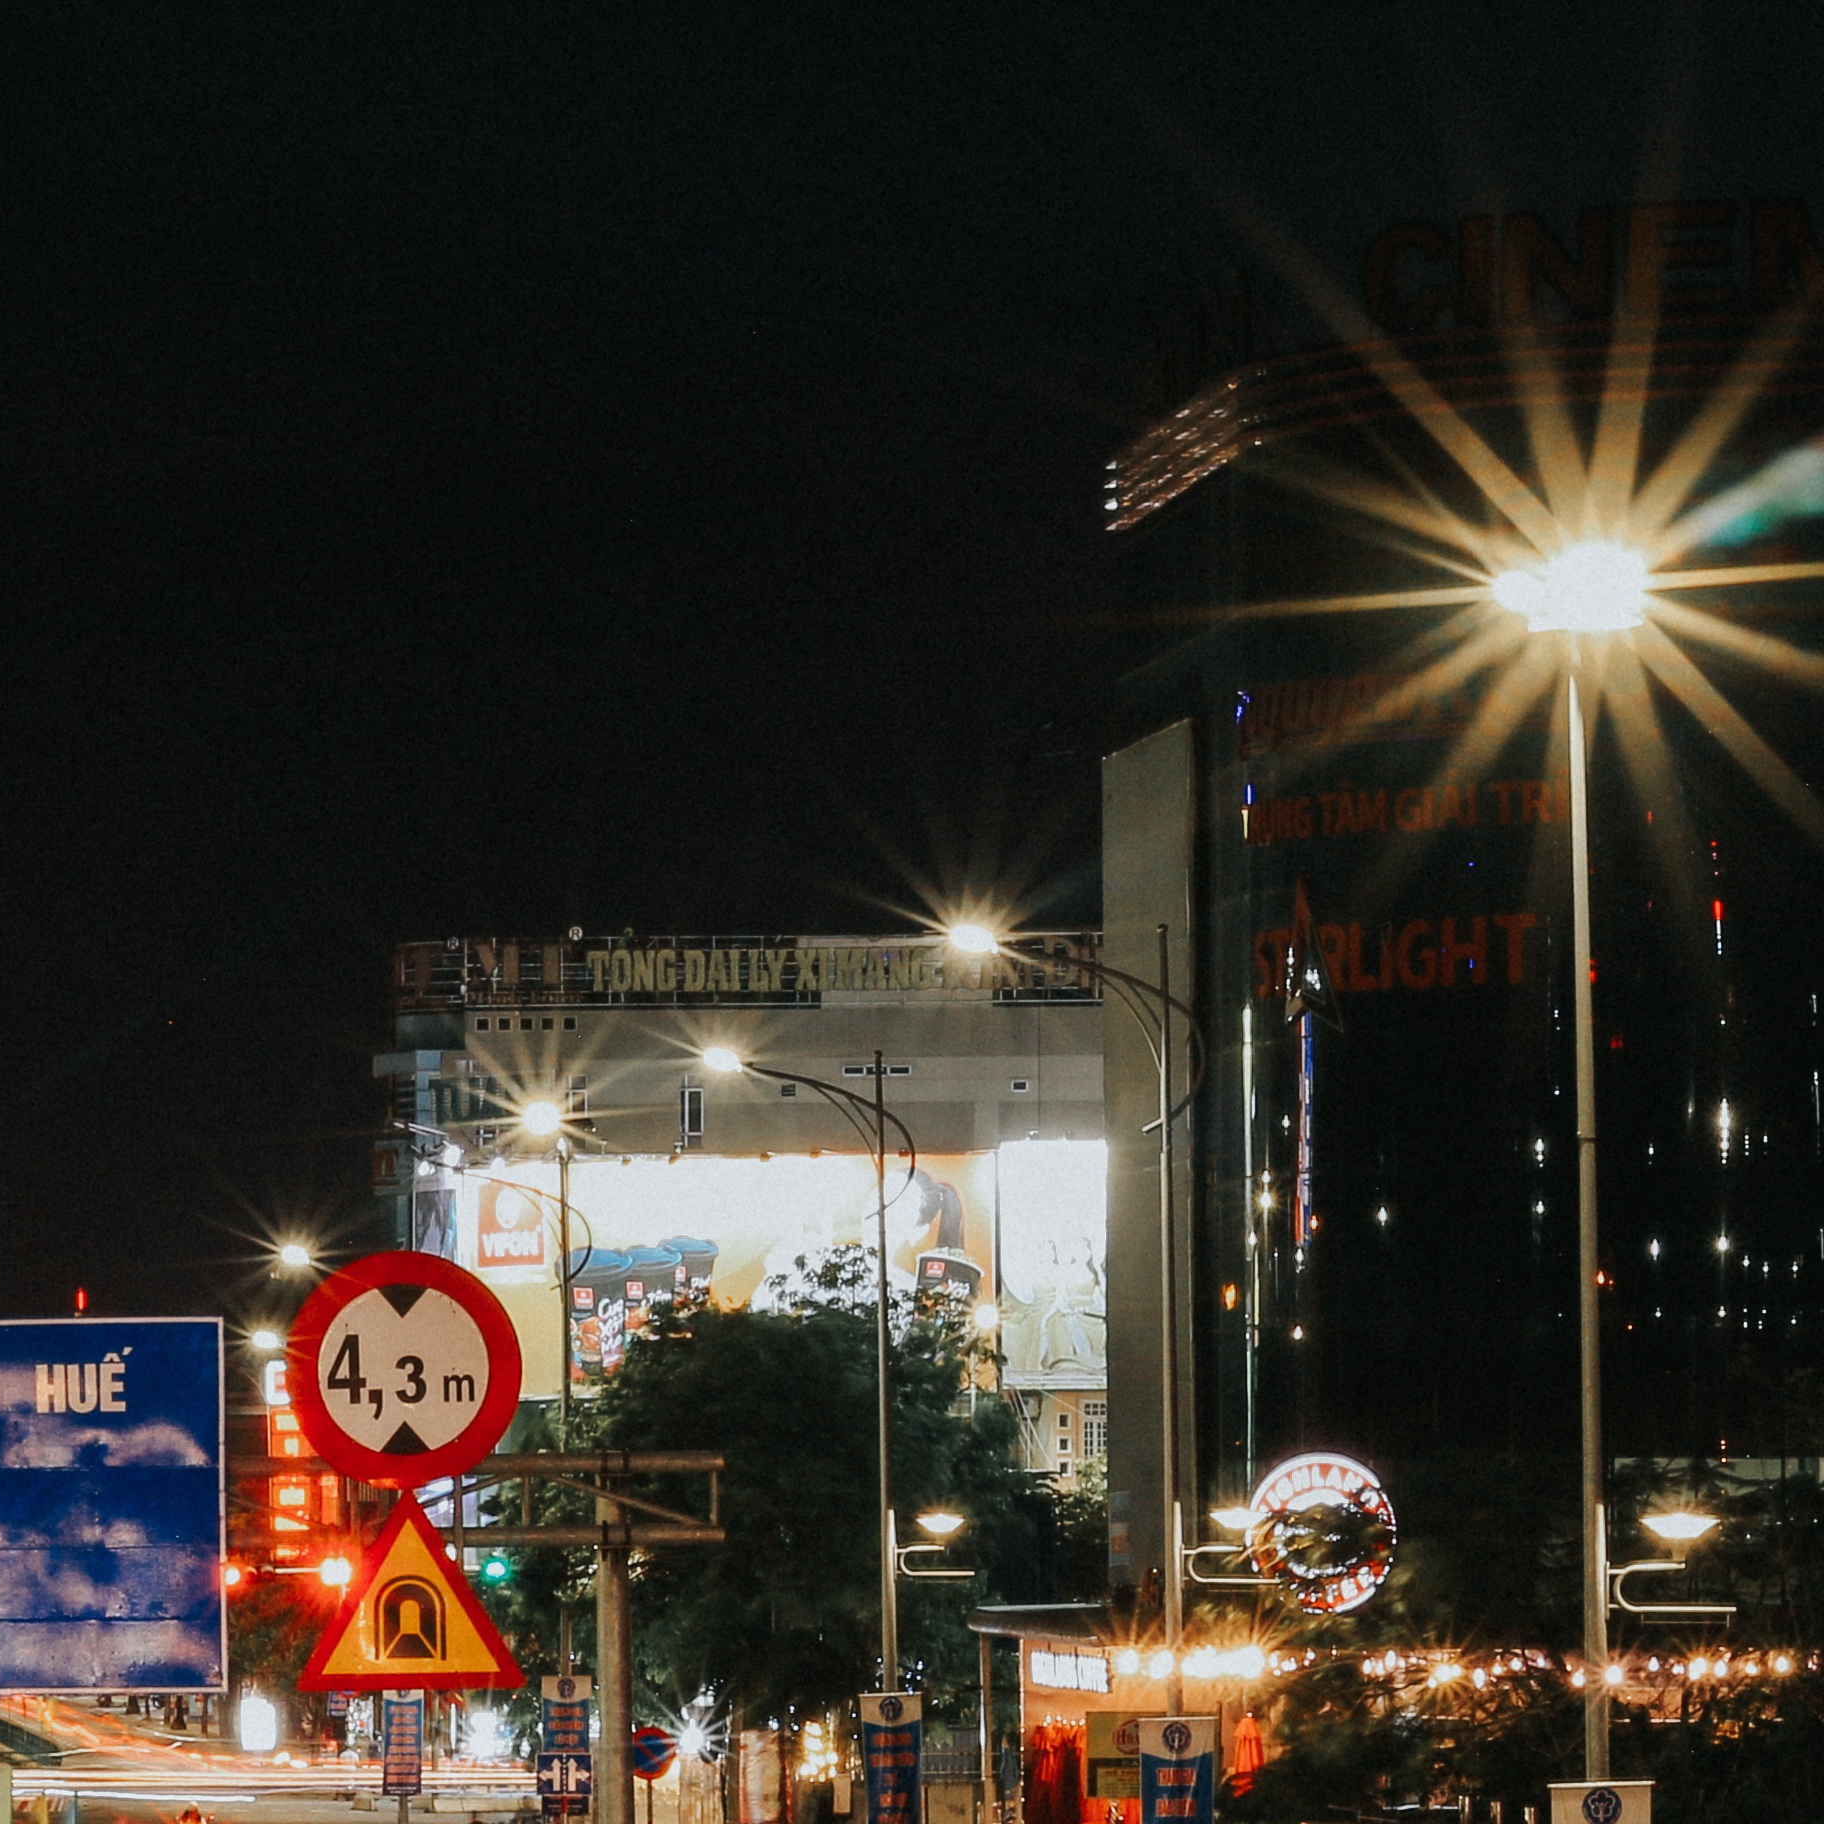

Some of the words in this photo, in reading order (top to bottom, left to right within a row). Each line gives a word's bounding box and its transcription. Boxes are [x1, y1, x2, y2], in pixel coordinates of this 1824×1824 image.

[35, 1346, 133, 1414] HUẾ
[327, 1334, 427, 1421] 4,3
[442, 1373, 476, 1403] m
